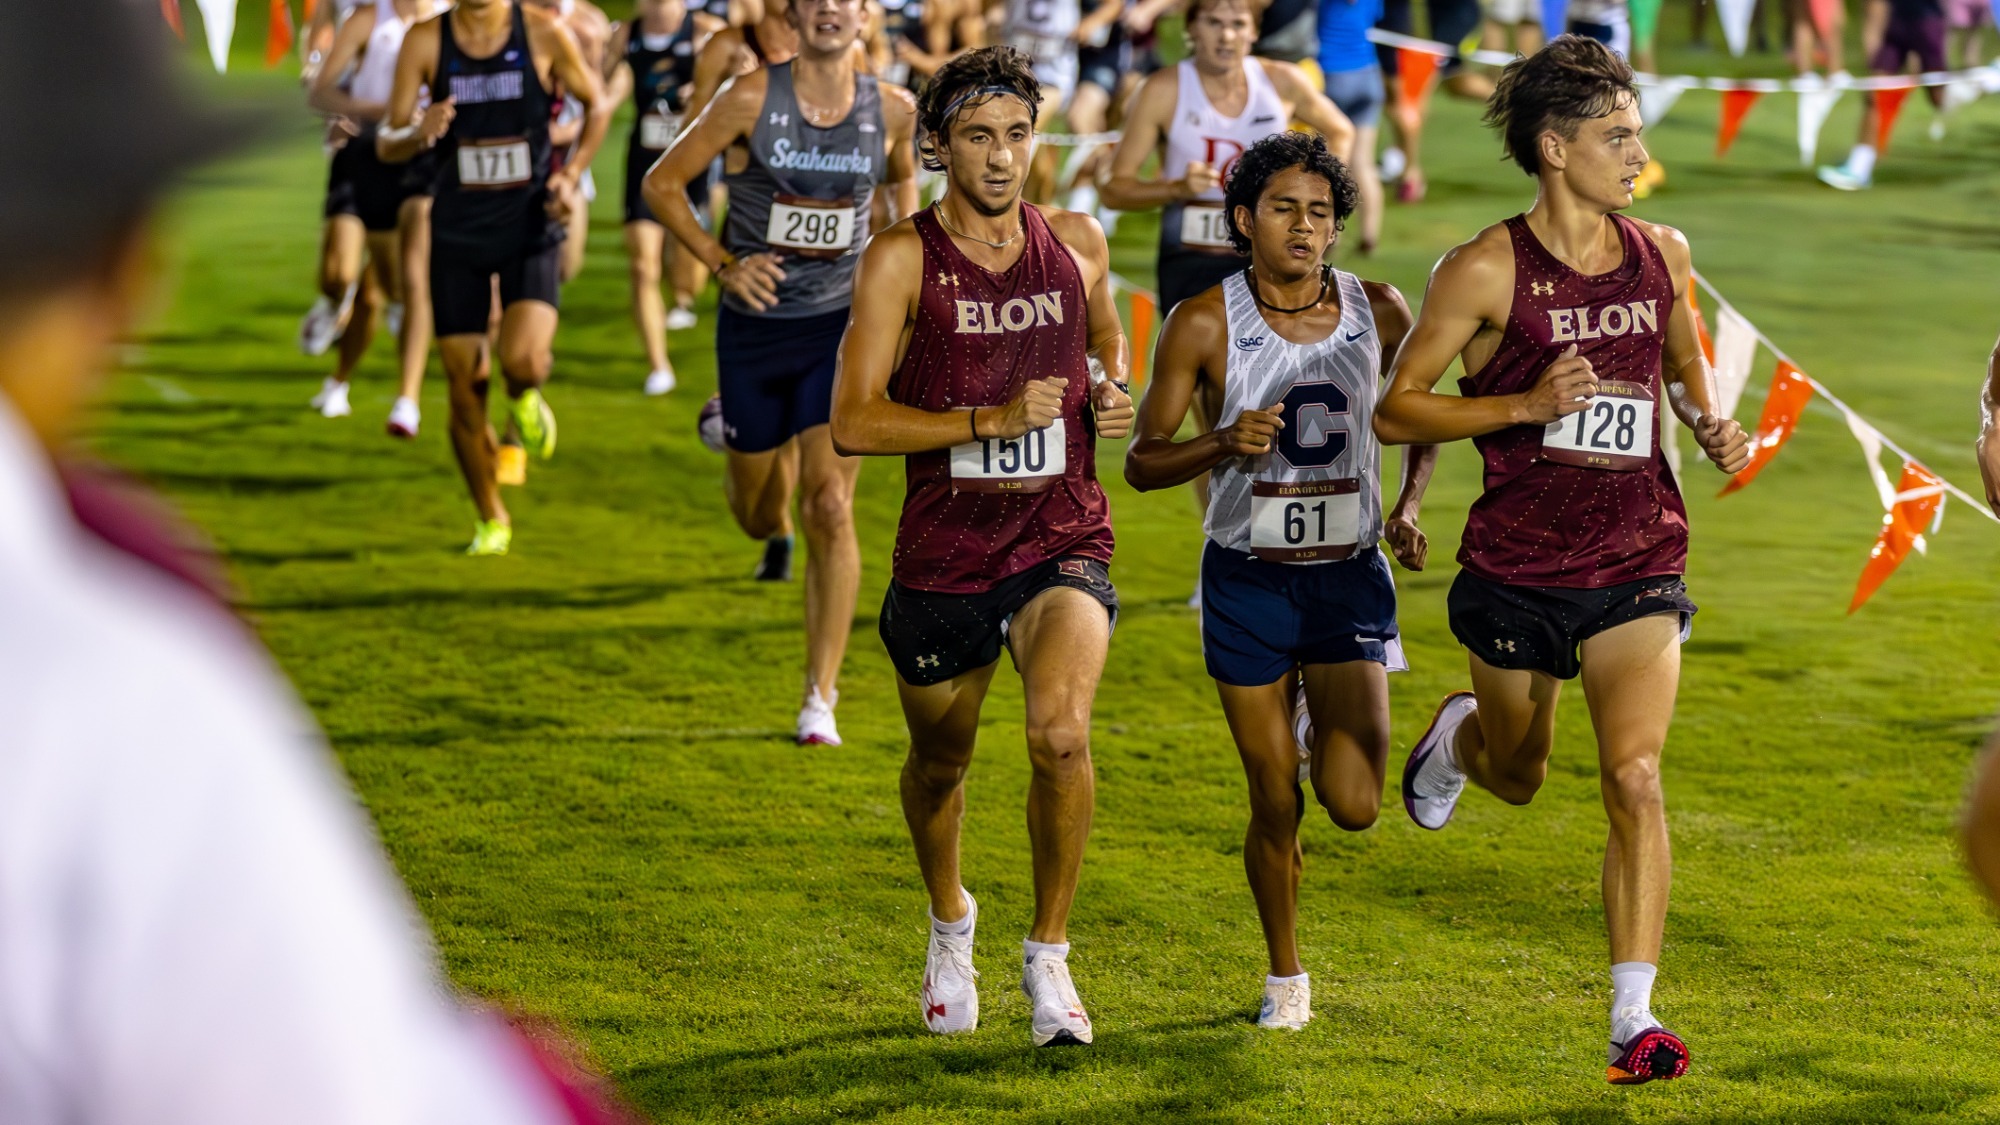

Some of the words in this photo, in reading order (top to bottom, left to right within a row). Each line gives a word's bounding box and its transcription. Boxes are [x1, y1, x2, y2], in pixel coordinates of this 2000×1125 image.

[474, 151, 516, 180] 171
[769, 138, 872, 174] Seahawks
[785, 211, 839, 244] 298
[1200, 213, 1228, 240] 10
[954, 291, 1064, 334] ELON
[1547, 299, 1658, 343] ELON
[1239, 336, 1264, 347] SAC
[1601, 385, 1633, 396] OPENER
[1276, 380, 1350, 469] C
[1575, 400, 1636, 451] 128
[982, 427, 1046, 474] 150
[1279, 486, 1301, 495] ELON
[1302, 484, 1336, 494] OPENER
[1284, 501, 1326, 545] 61
